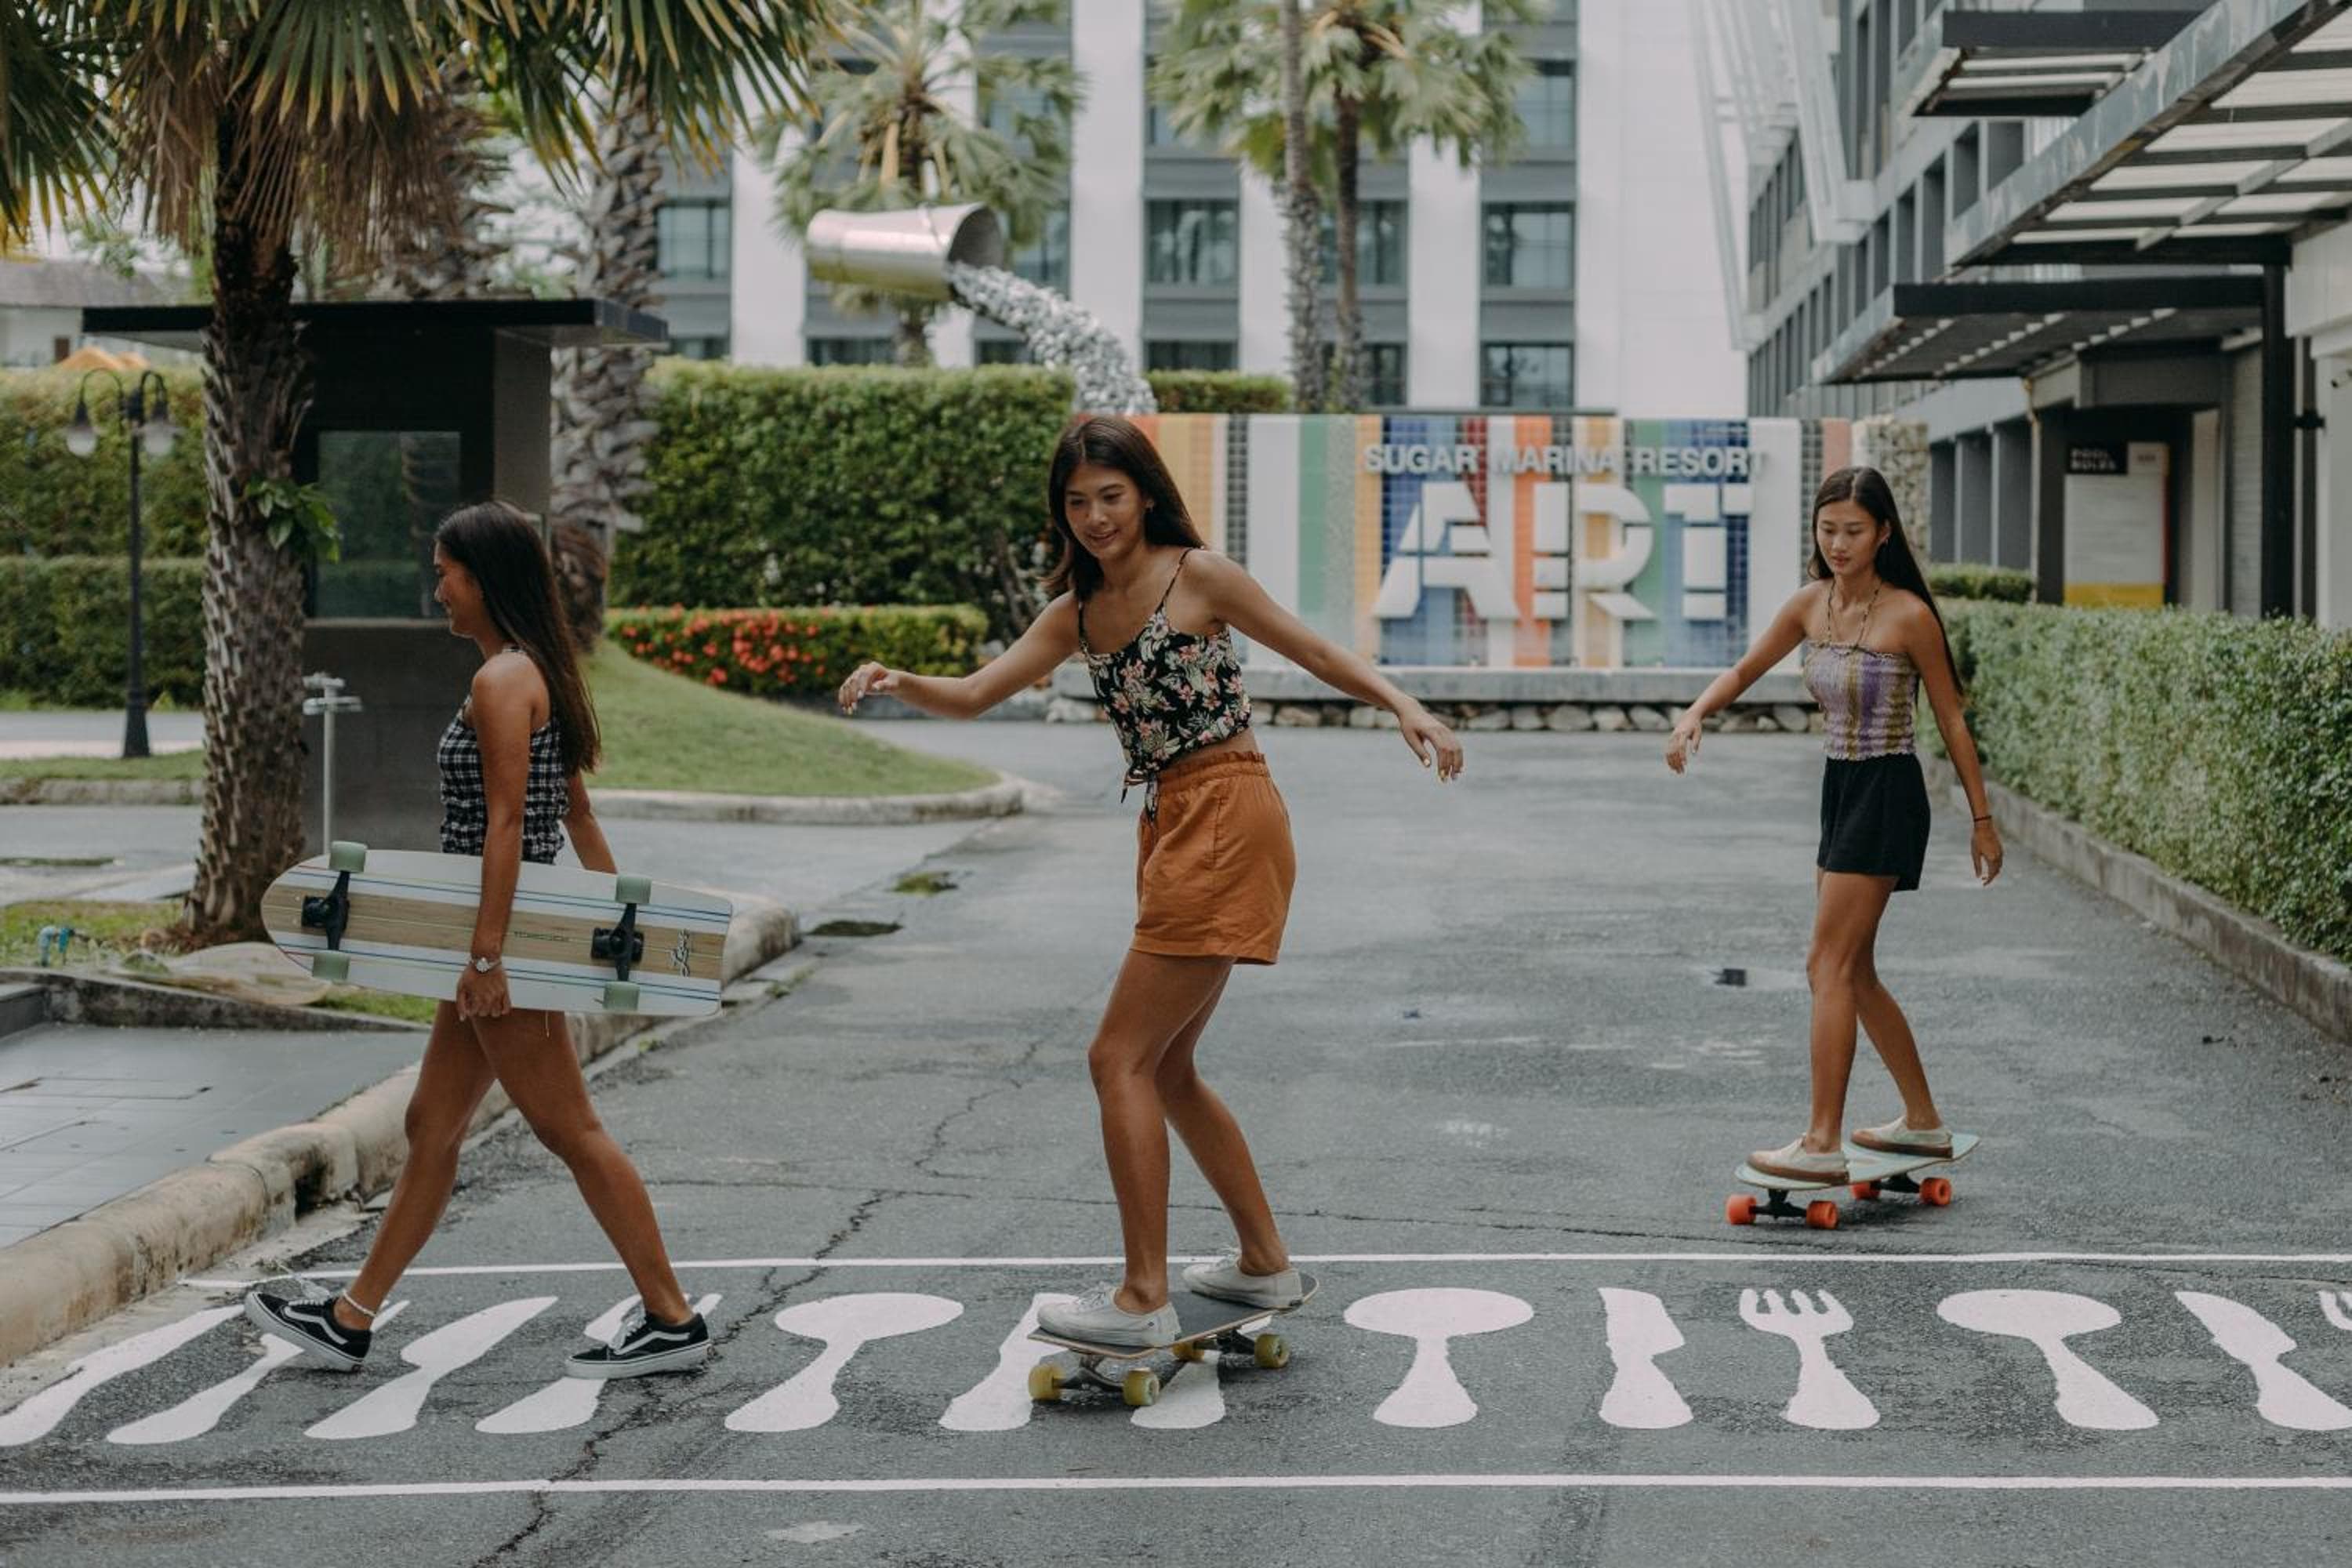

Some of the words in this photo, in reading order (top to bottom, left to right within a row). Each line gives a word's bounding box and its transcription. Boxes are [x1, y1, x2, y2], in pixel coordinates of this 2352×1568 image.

[1364, 445, 1479, 475] SUGAR
[1492, 445, 1621, 476] MARINA
[1632, 446, 1769, 477] RESORT
[1374, 481, 1756, 622] ART
